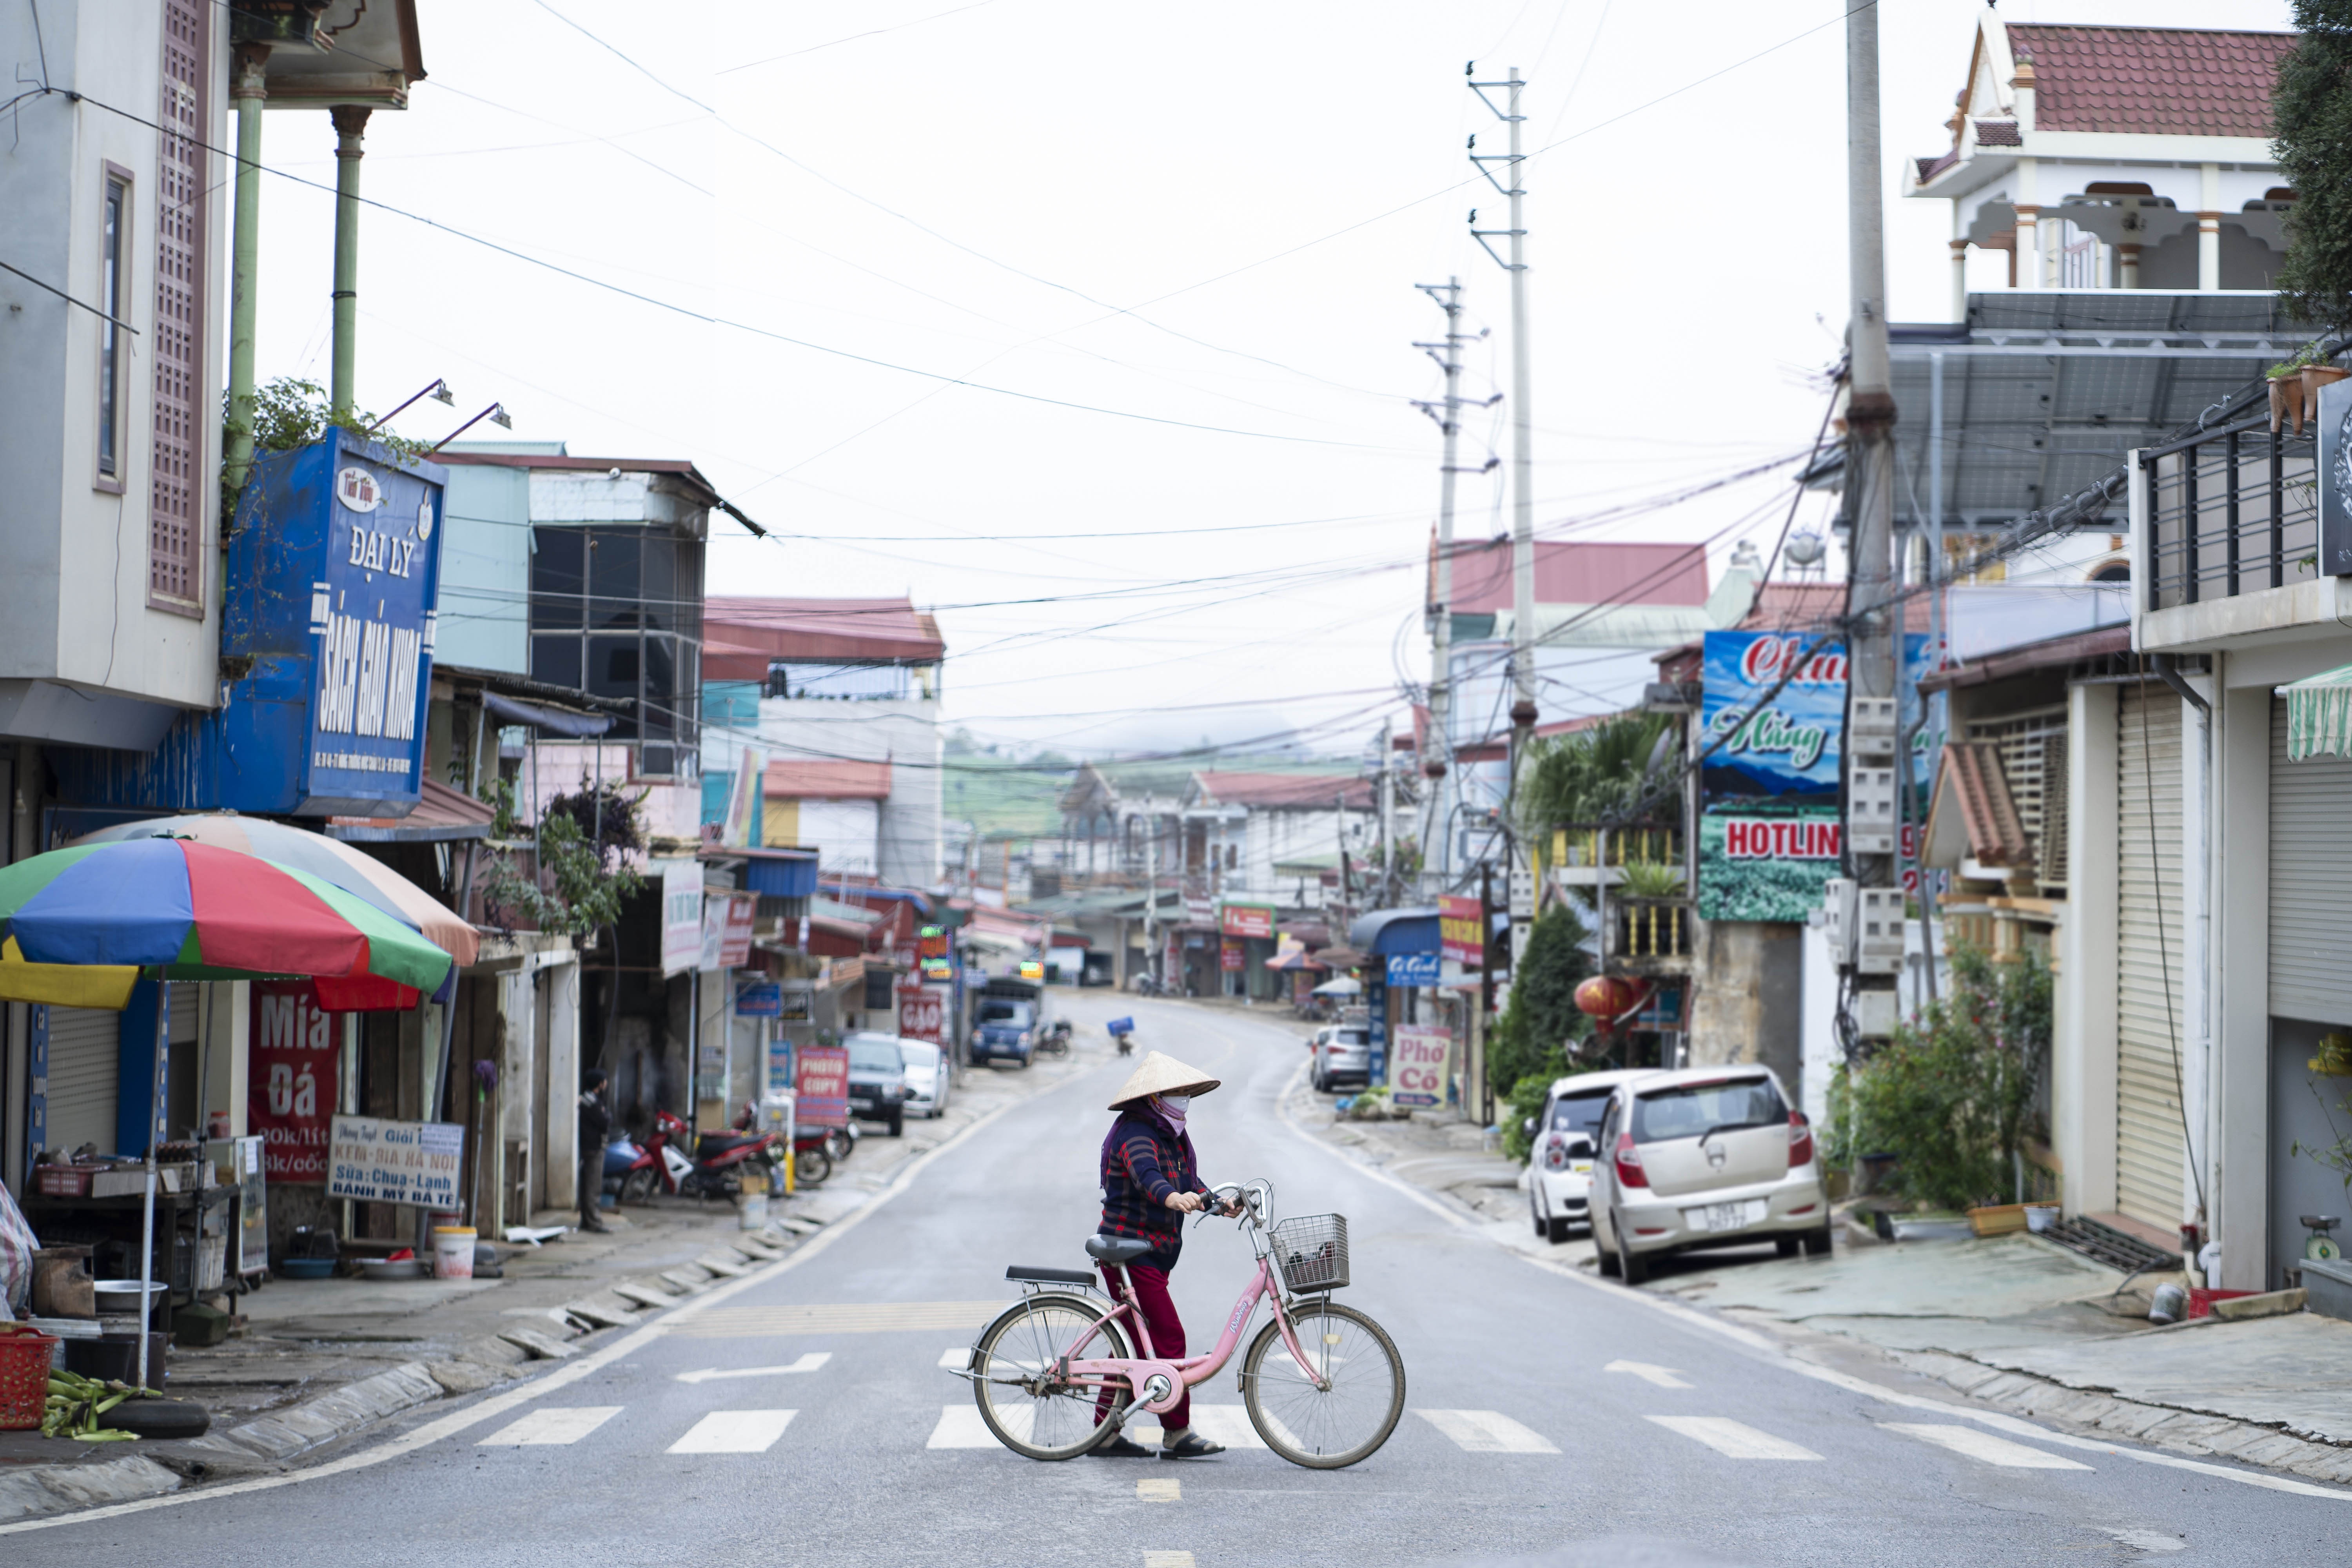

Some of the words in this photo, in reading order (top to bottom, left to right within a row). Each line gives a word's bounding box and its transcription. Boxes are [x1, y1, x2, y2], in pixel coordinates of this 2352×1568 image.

[349, 525, 387, 583] ĐẠI
[389, 526, 415, 578] LÝ
[319, 589, 361, 733] SÁCH
[356, 599, 390, 738] GIÁO
[384, 627, 421, 741] KHOA
[1727, 822, 1842, 856] HOTLIN
[260, 994, 331, 1050] Mía
[1398, 1039, 1446, 1064] Phở
[268, 1062, 316, 1117] Đá
[385, 1129, 413, 1145] Giải
